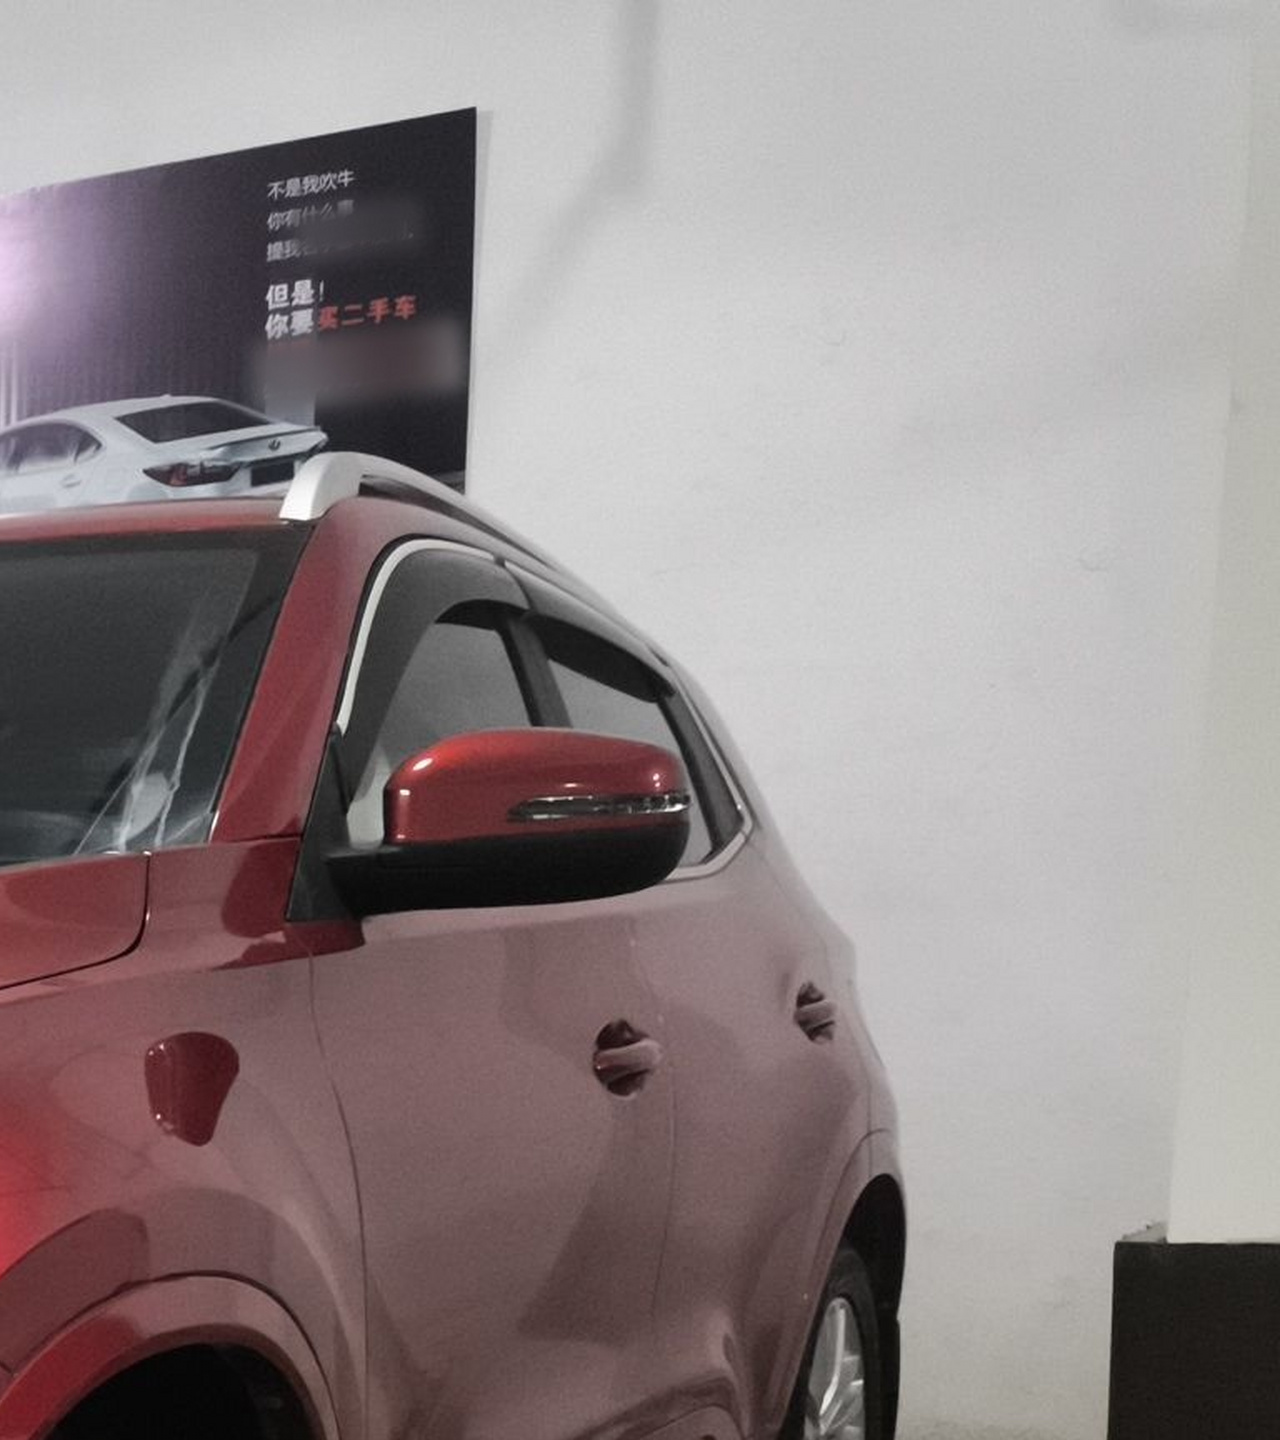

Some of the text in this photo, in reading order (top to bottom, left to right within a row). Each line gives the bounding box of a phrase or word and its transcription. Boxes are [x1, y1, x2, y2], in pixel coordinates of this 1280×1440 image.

[267, 169, 355, 200] 不是我吹牛
